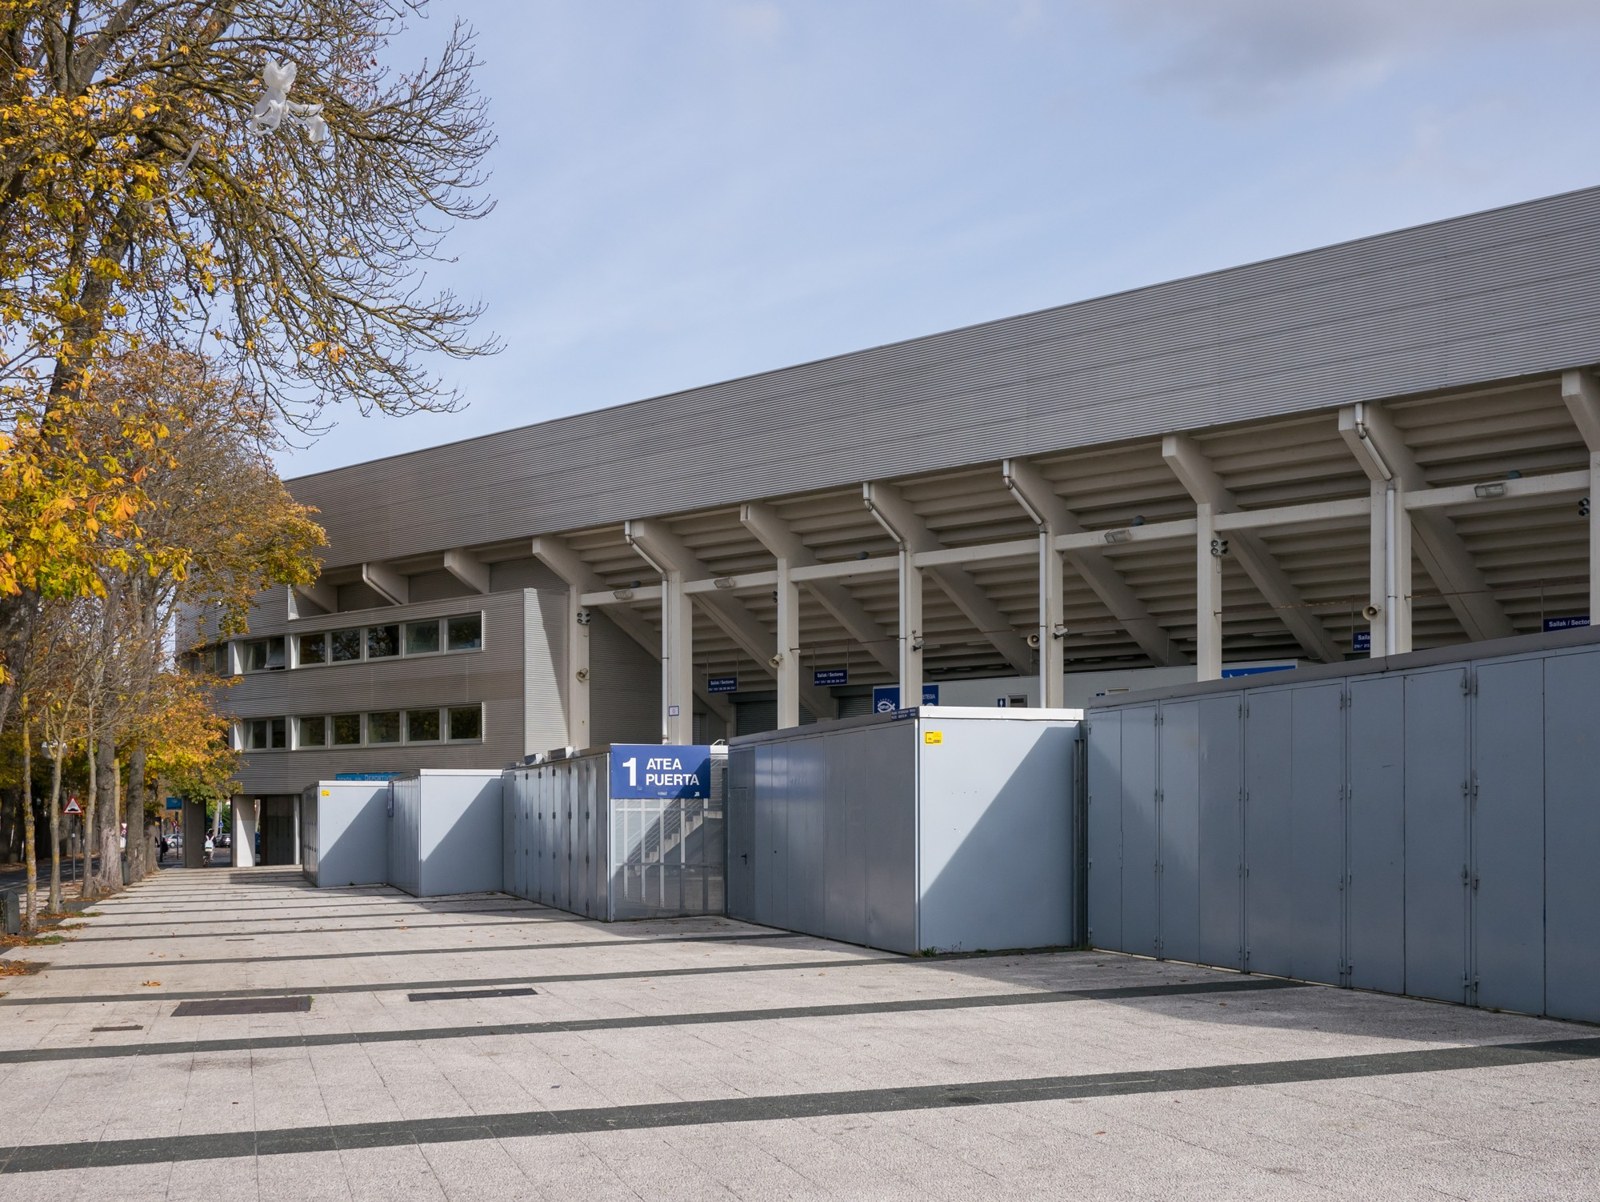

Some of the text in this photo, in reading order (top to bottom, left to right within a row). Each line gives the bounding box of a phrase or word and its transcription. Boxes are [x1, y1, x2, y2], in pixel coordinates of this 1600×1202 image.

[646, 758, 682, 770] ATEA
[622, 757, 637, 787] 1
[645, 774, 700, 786] PUERTA
